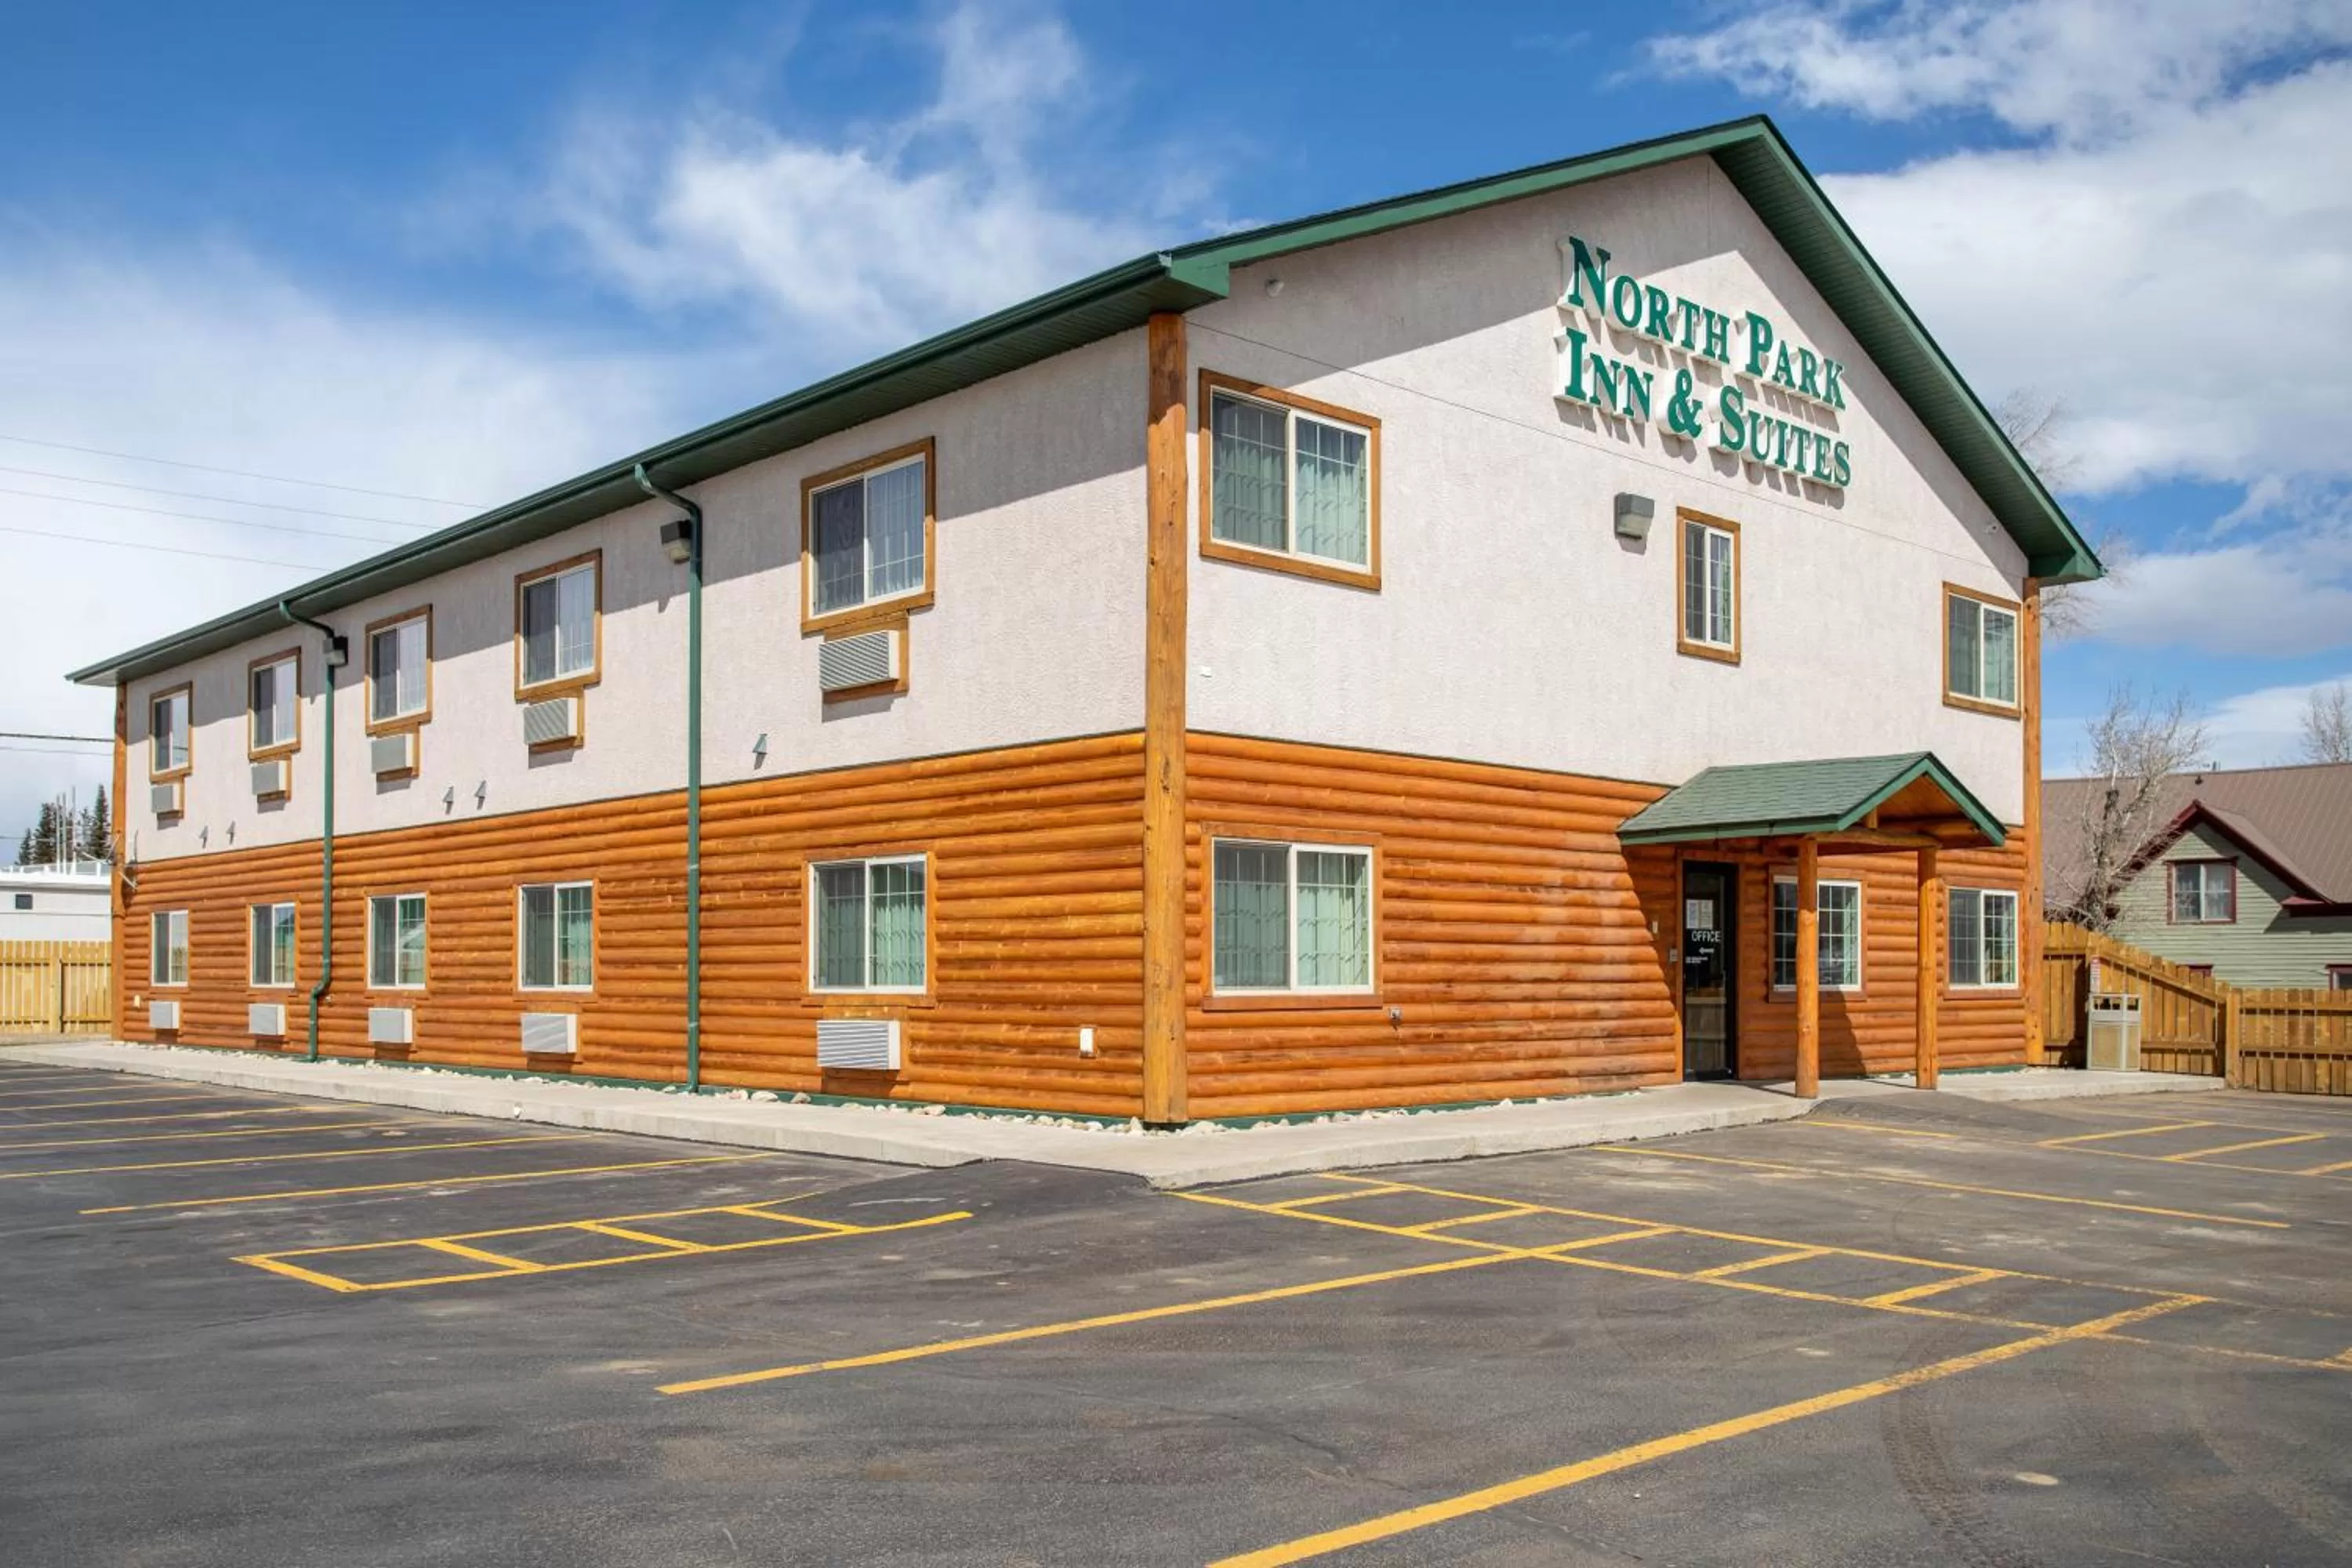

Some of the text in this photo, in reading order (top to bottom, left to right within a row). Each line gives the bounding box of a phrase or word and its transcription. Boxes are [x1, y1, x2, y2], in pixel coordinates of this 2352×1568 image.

[1567, 235, 1846, 411] NORTH PARK
[1565, 327, 1852, 487] INN & SUITES
[1691, 930, 1722, 942] OFFICE
